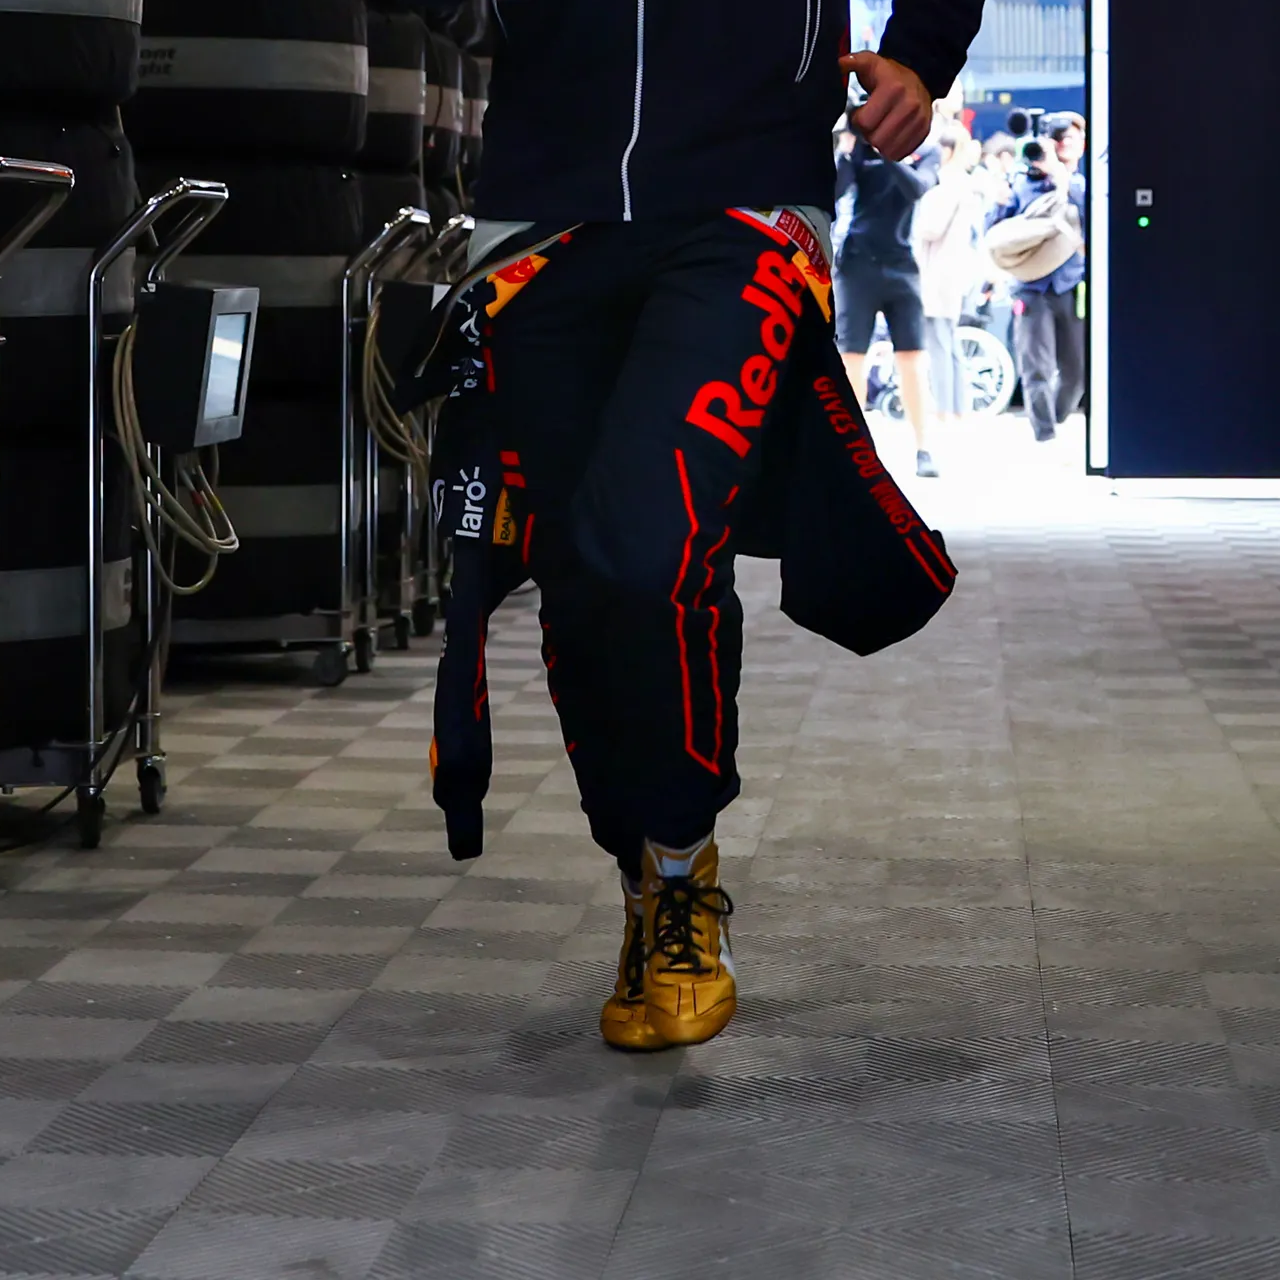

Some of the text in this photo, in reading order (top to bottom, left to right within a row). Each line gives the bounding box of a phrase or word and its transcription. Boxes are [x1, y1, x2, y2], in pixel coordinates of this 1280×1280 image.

[812, 375, 859, 436] GIVES
[844, 436, 886, 480] YOU
[455, 466, 487, 539] laro
